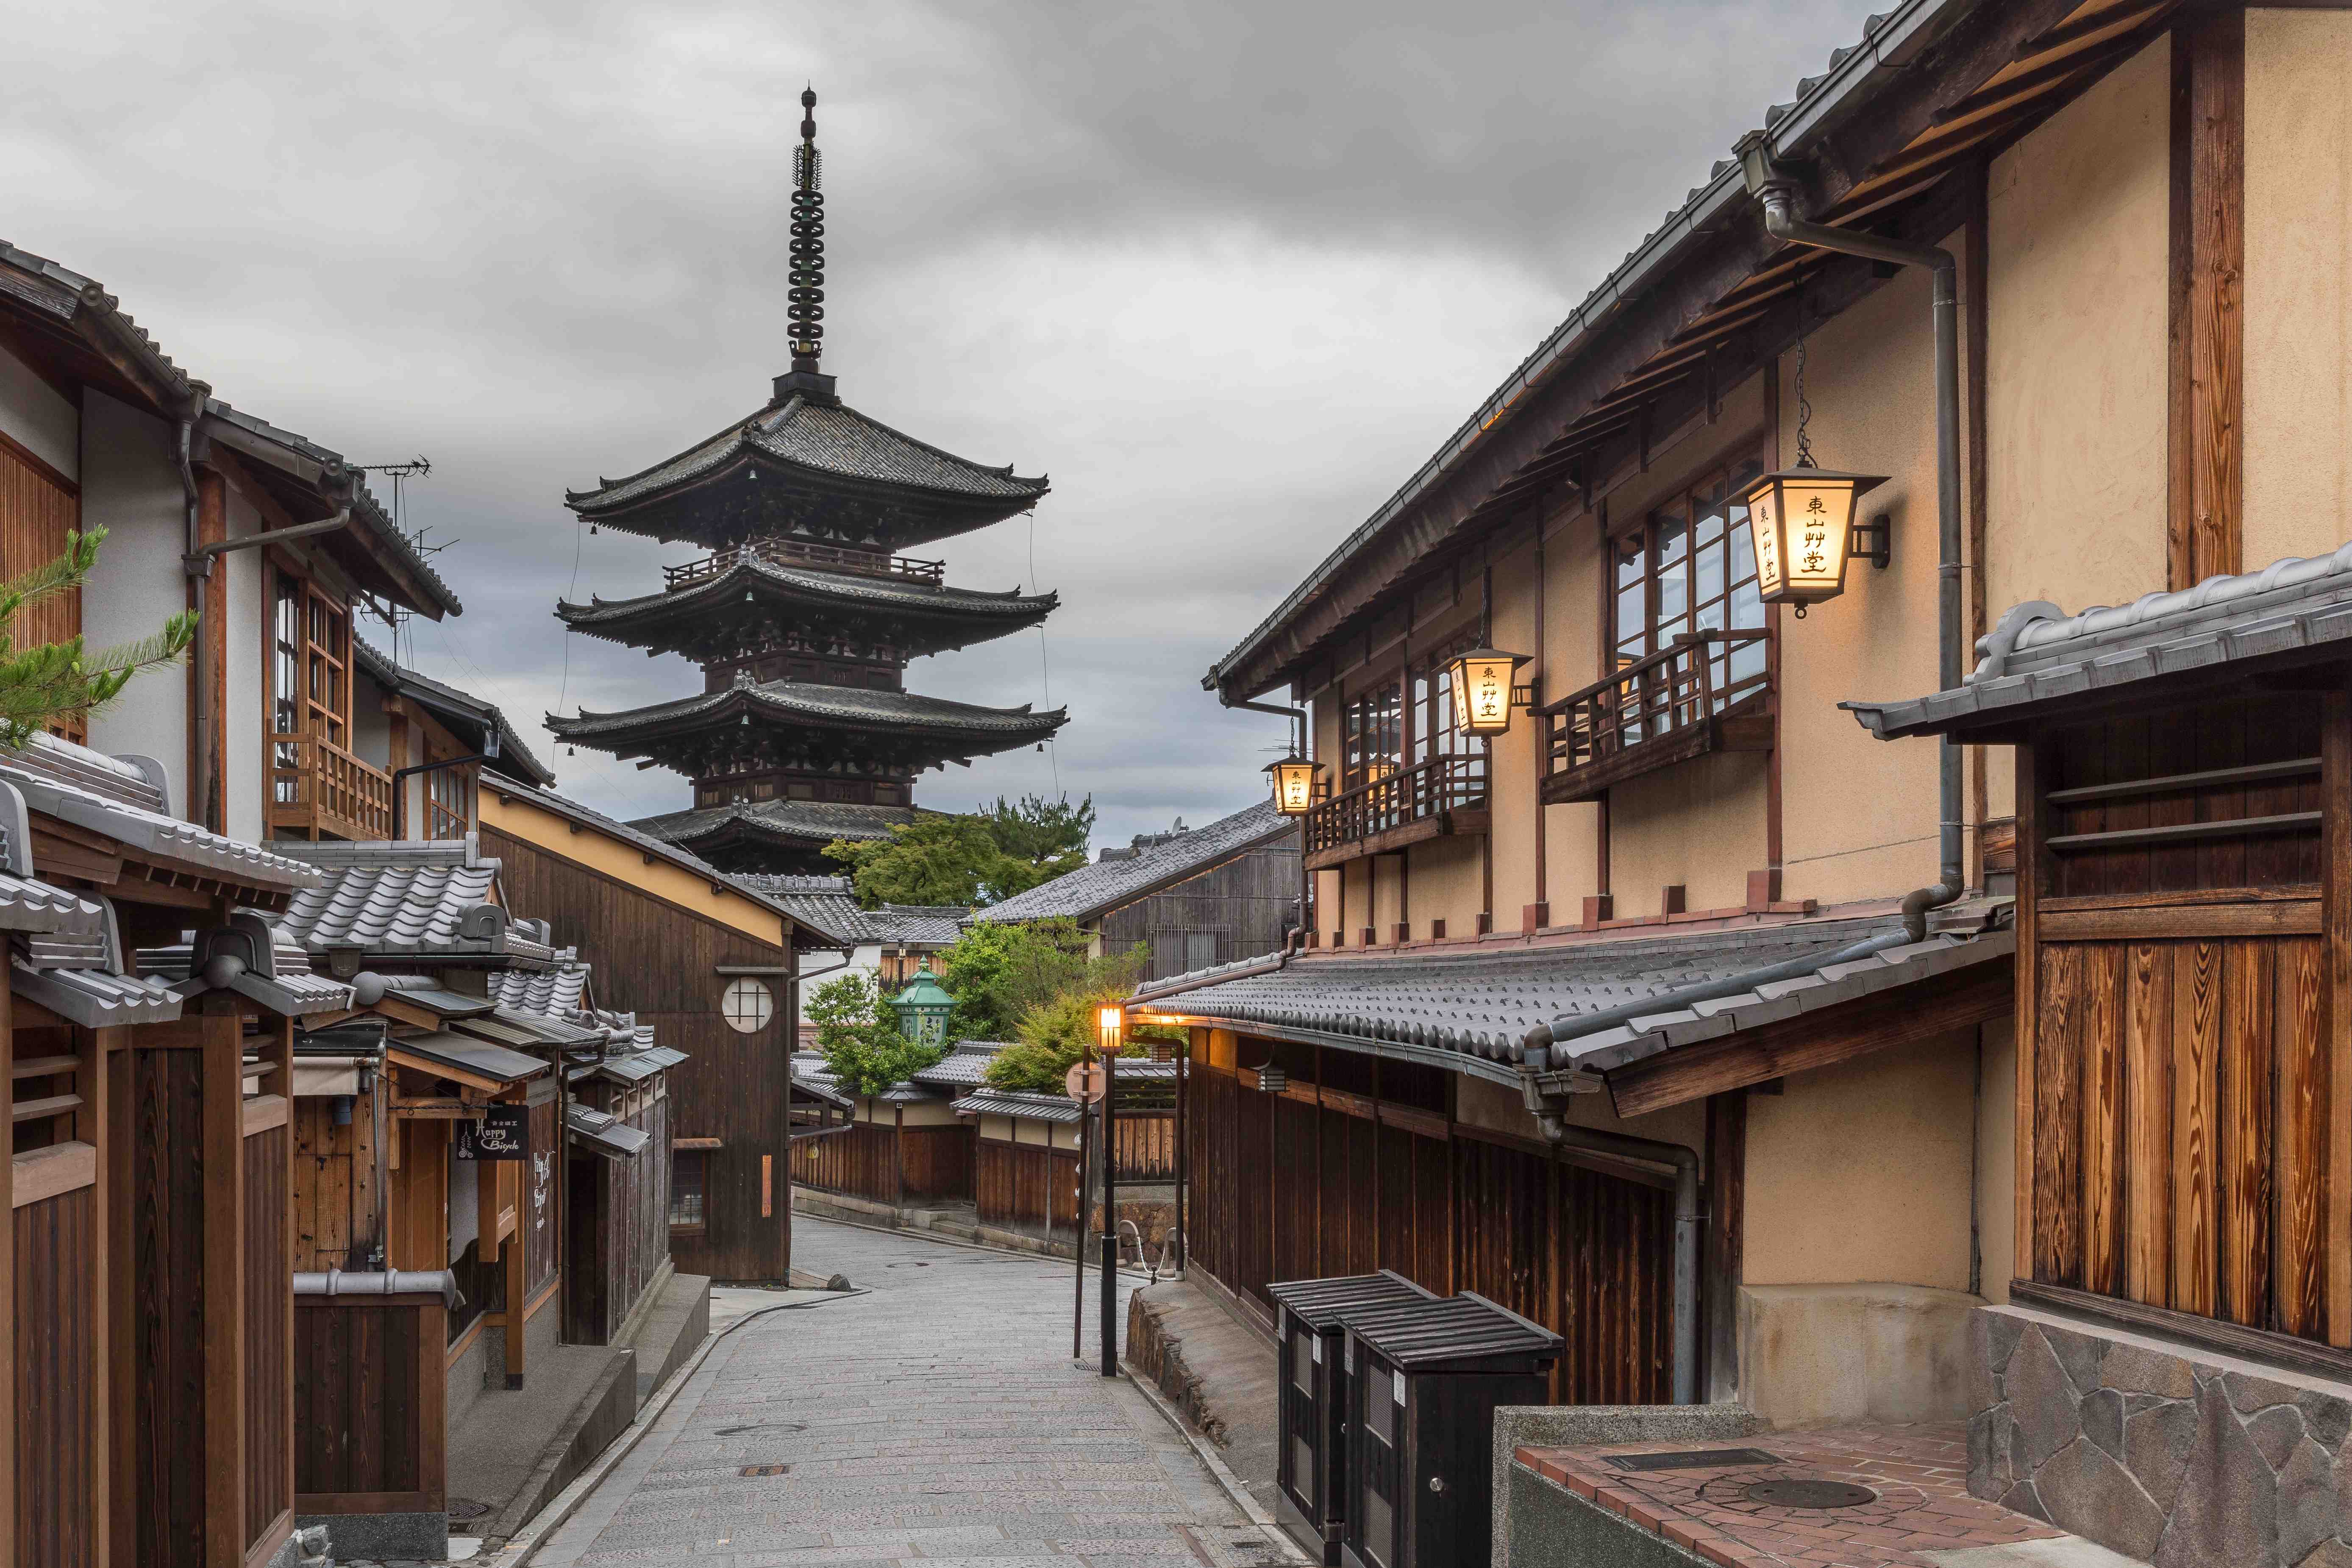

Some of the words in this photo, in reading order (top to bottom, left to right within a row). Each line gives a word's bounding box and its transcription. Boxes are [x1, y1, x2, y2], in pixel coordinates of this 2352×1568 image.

[1801, 495, 1827, 573] 東山艸堂
[1481, 666, 1497, 717] 東山艸堂
[475, 1118, 506, 1140] Happy
[481, 1139, 519, 1153] Bicycle
